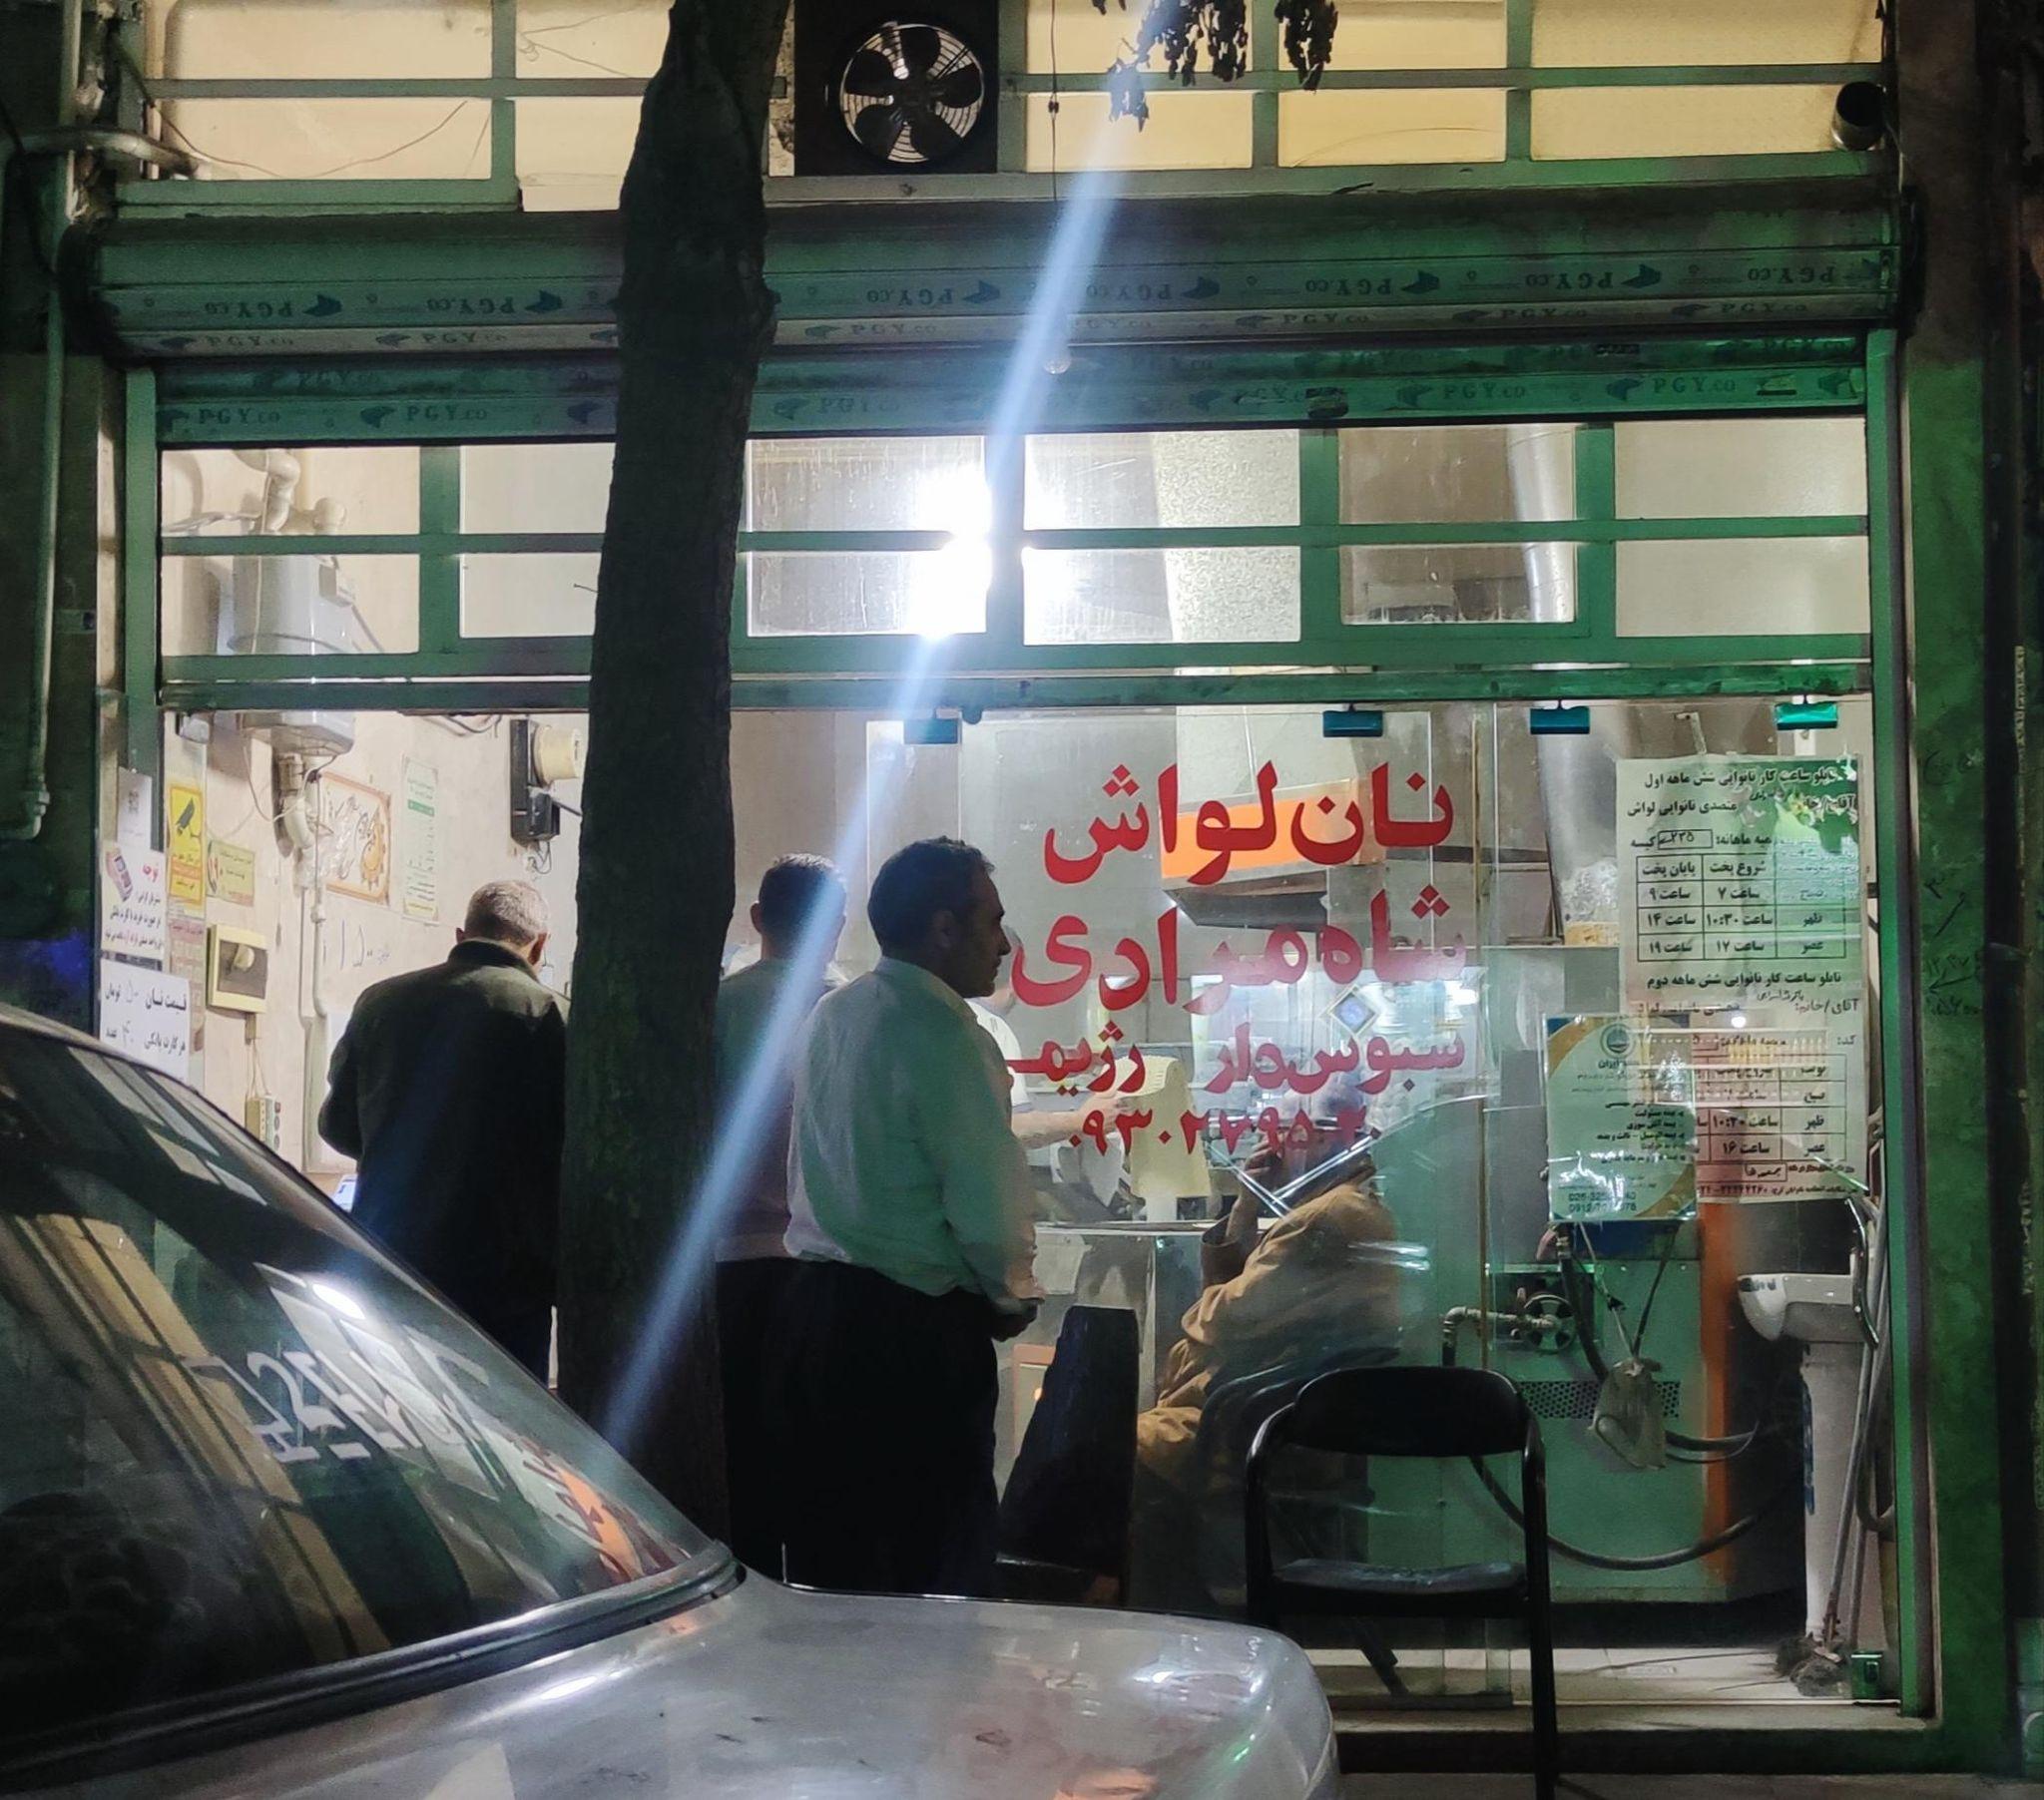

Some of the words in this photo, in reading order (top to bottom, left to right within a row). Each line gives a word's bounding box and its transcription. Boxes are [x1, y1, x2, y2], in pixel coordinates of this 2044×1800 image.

[1645, 772, 1665, 789] اول
[1761, 769, 1777, 786] کار
[1780, 768, 1810, 782] ساعت
[1290, 761, 1454, 866] نان
[1627, 801, 1657, 817] لواش
[1044, 759, 1278, 885] لواش
[1642, 862, 1667, 879] پخت
[1669, 861, 1696, 878] پایان
[1649, 887, 1658, 901] ۹
[1659, 886, 1692, 900] ساعت
[1718, 886, 1728, 900] ۷
[1730, 886, 1761, 900] ساعت
[1665, 913, 1697, 926] ساعت
[1743, 913, 1774, 926] ساعت
[1649, 941, 1662, 955] ۱۹
[1664, 941, 1694, 954] ساعت
[1734, 940, 1765, 953] ساعت
[1647, 977, 1670, 990] دوم
[1766, 972, 1783, 988] کار
[1785, 973, 1816, 985] ساعت
[1818, 972, 1842, 988] تابلو
[1008, 1020, 1146, 1098] رژیم
[1748, 1116, 1780, 1127] ساعت
[1804, 1115, 1825, 1130] ظهر
[1740, 1141, 1771, 1153] ساعت
